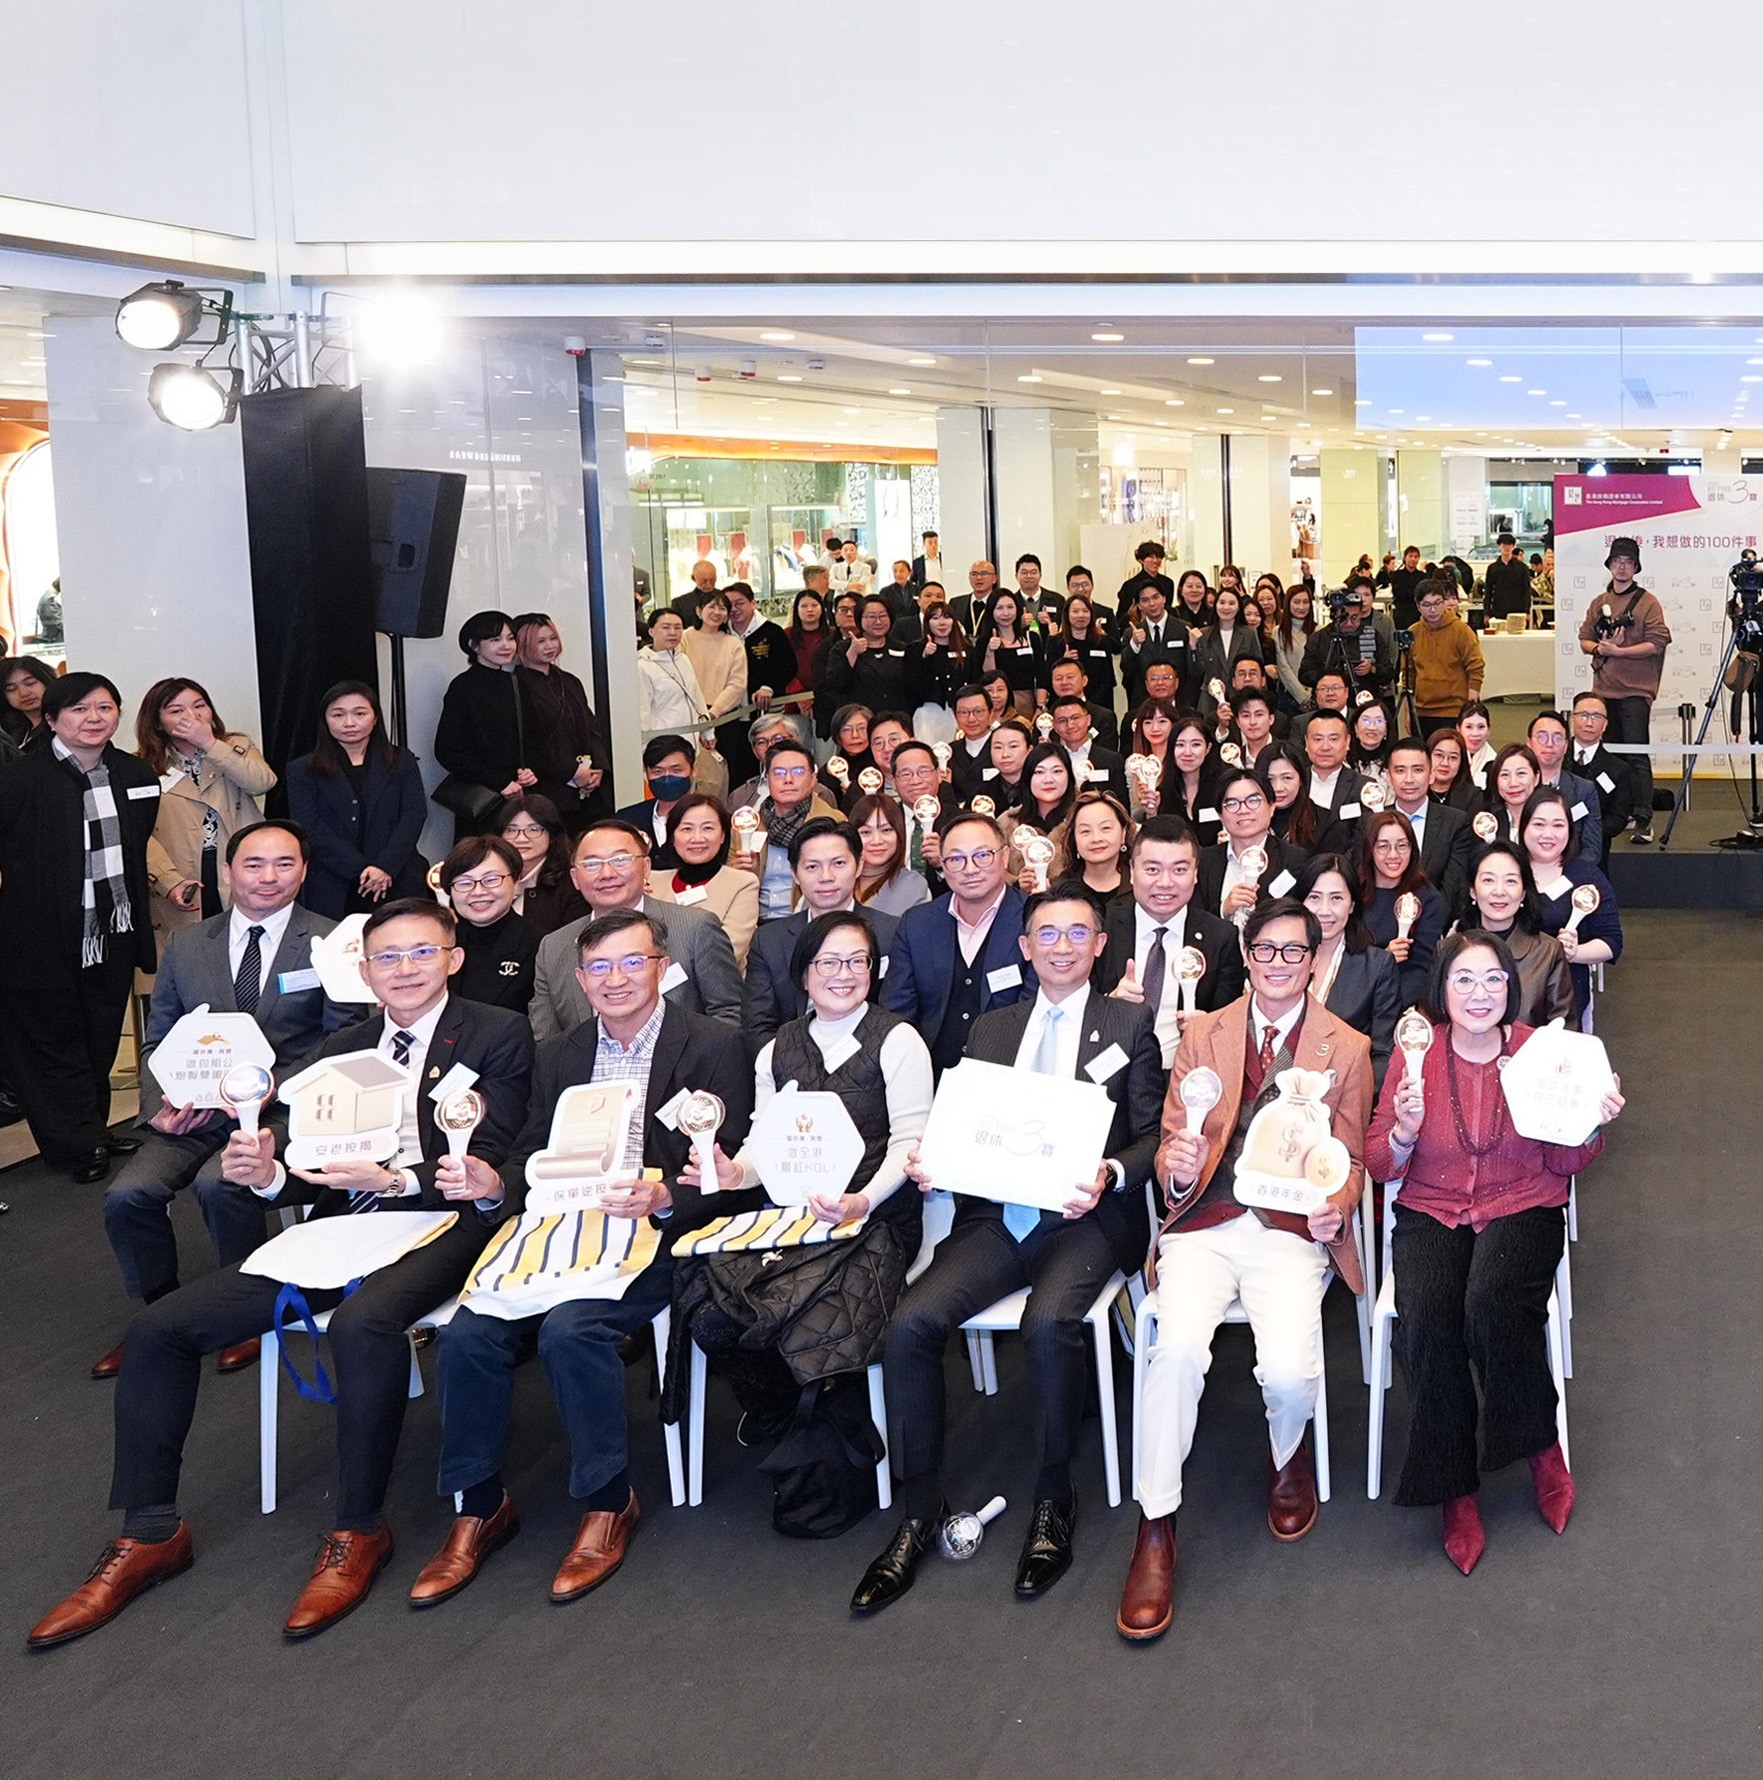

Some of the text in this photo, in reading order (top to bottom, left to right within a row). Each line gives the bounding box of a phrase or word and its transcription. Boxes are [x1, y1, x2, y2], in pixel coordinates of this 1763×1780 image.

[314, 1140, 372, 1157] 安老按揭
[1257, 1184, 1303, 1202] 香港年金
